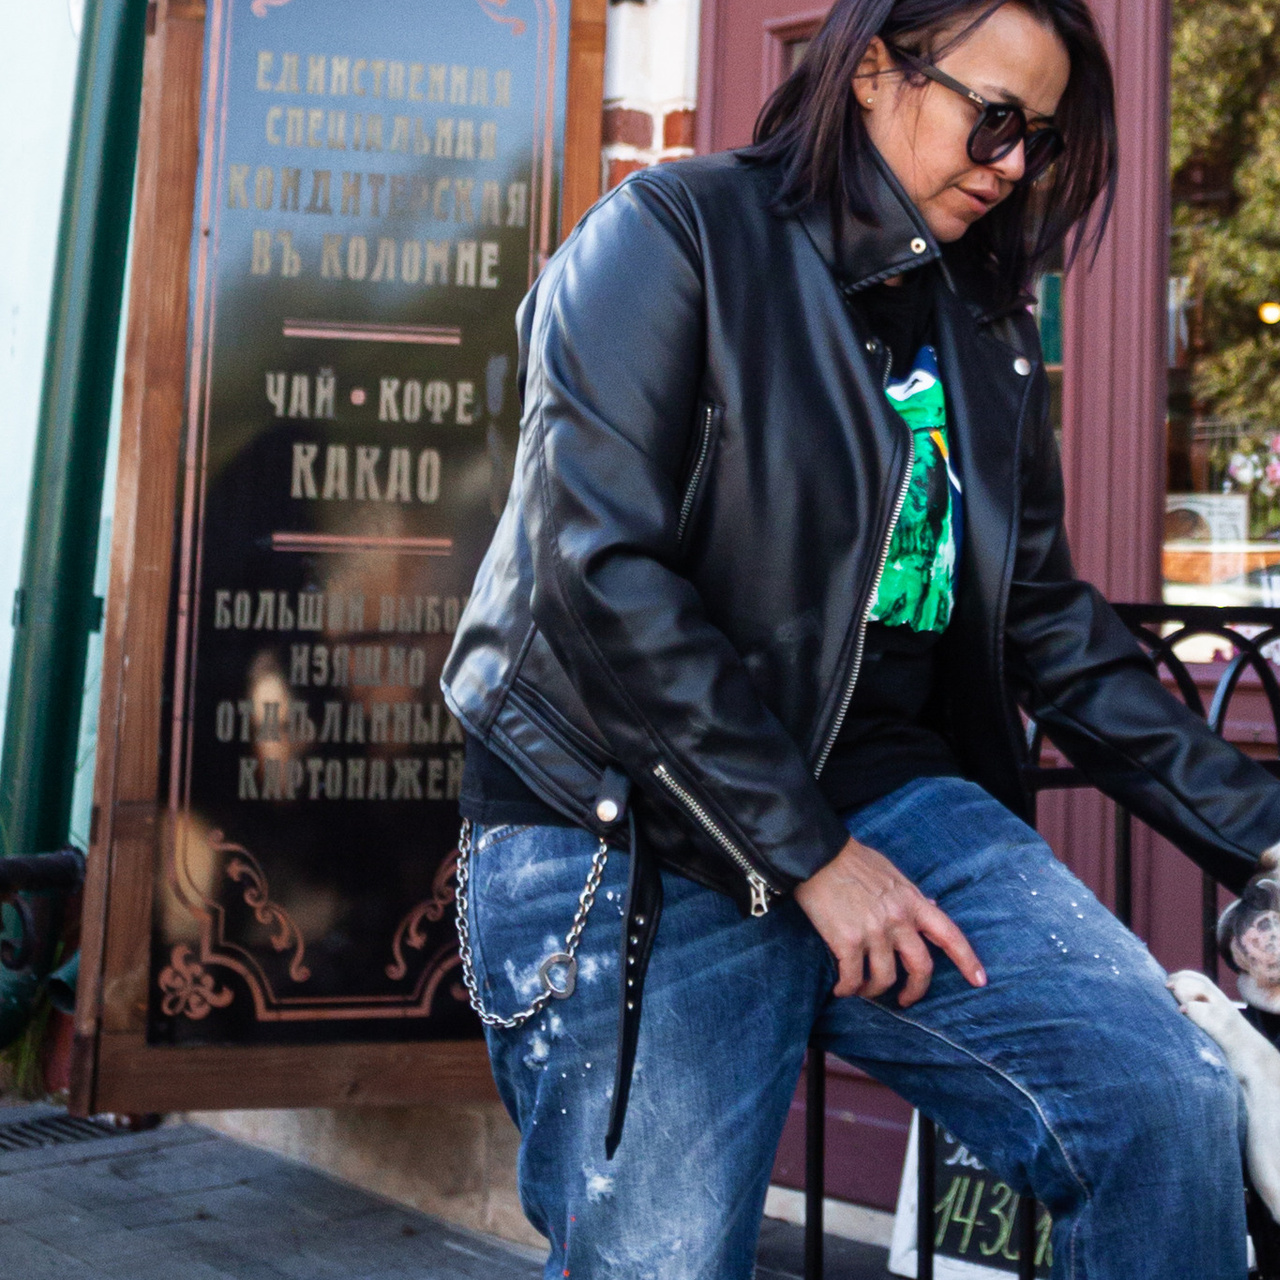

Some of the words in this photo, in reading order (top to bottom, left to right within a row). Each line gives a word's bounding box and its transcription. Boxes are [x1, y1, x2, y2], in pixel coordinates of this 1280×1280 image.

[255, 50, 513, 108] ЕДИНСТВЕННАЯ
[226, 163, 528, 228] КОНДИТЕРСКАЯ
[251, 229, 302, 278] ВЪ
[264, 366, 336, 419] ЧАЙ
[377, 376, 475, 425] КОФЕ
[290, 442, 442, 505] КАКАО
[379, 594, 467, 634] ВЫБО
